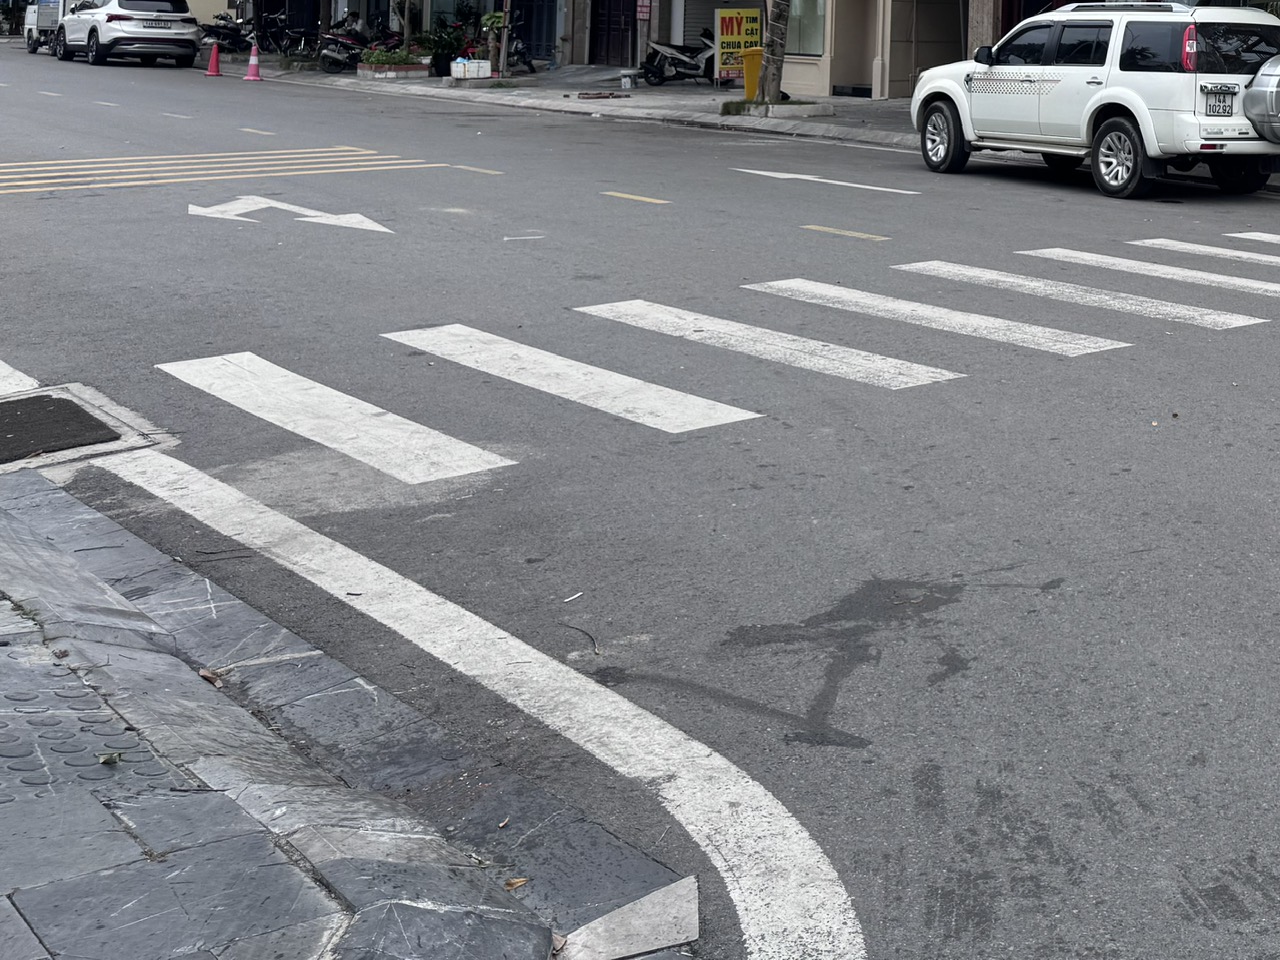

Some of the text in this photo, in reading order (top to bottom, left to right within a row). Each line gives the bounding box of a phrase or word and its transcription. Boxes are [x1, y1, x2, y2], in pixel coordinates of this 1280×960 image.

[721, 12, 743, 36] MỲ
[721, 41, 741, 49] CHUA
[1214, 94, 1226, 104] 14A
